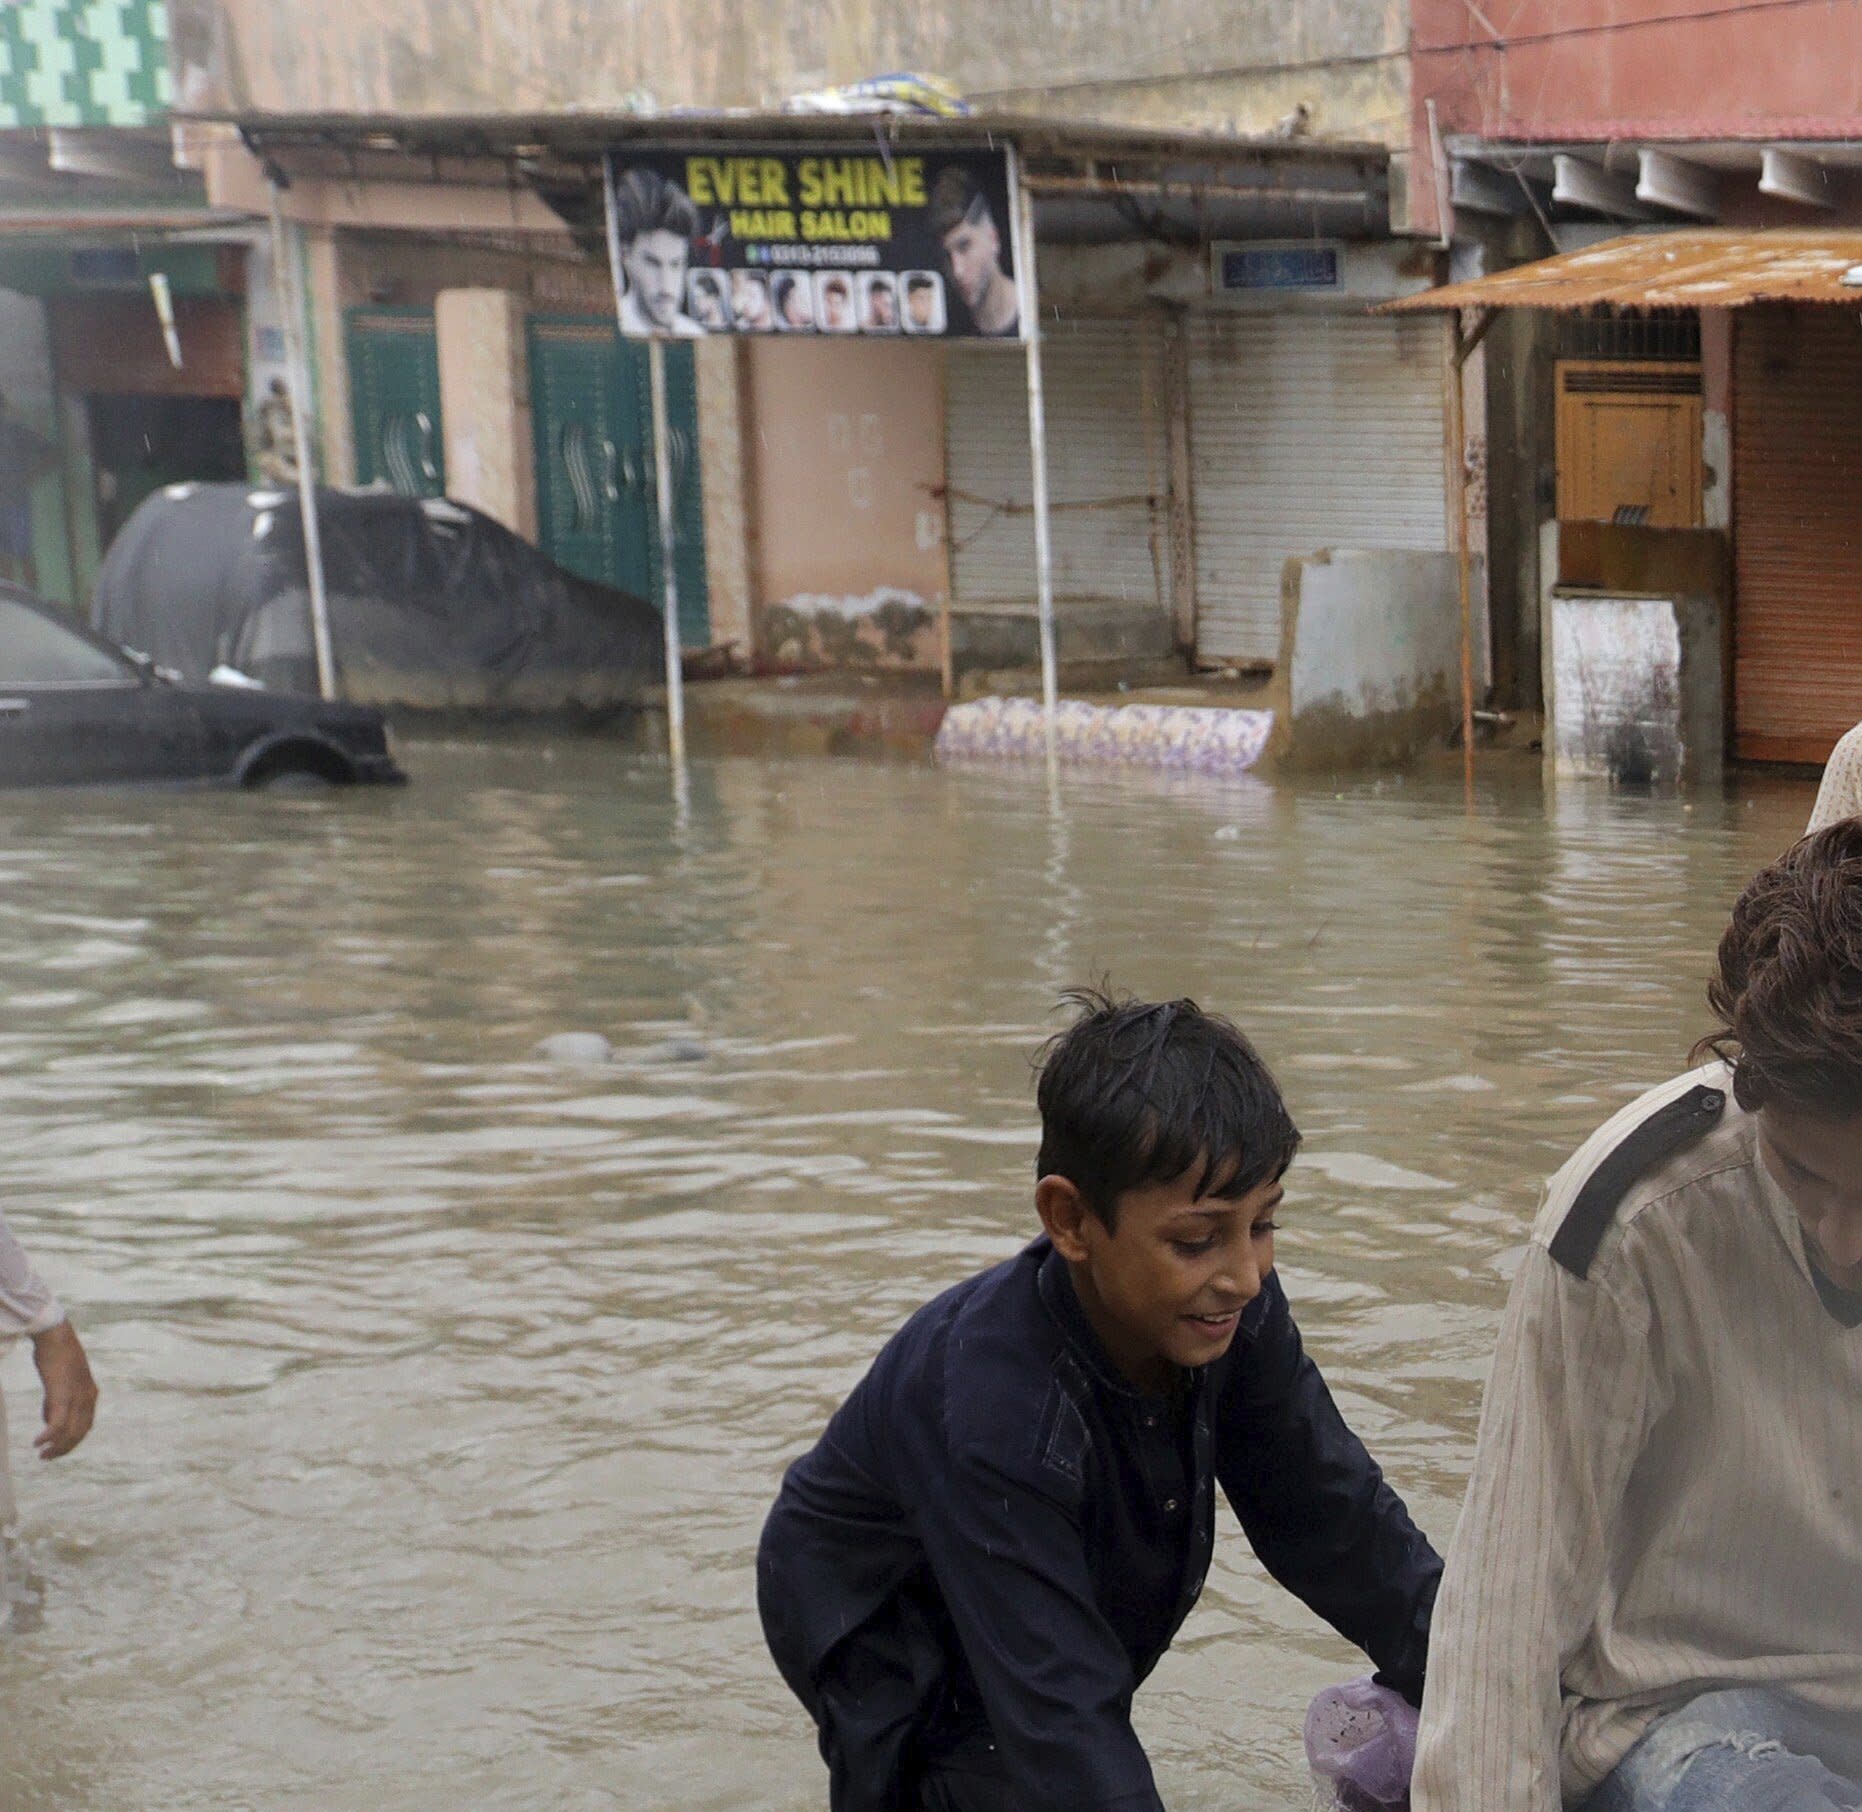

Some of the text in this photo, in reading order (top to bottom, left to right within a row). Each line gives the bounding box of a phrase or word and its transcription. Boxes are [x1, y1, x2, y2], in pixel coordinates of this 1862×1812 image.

[686, 157, 929, 208] EVER SHINE
[729, 209, 893, 241] HAIR SALON
